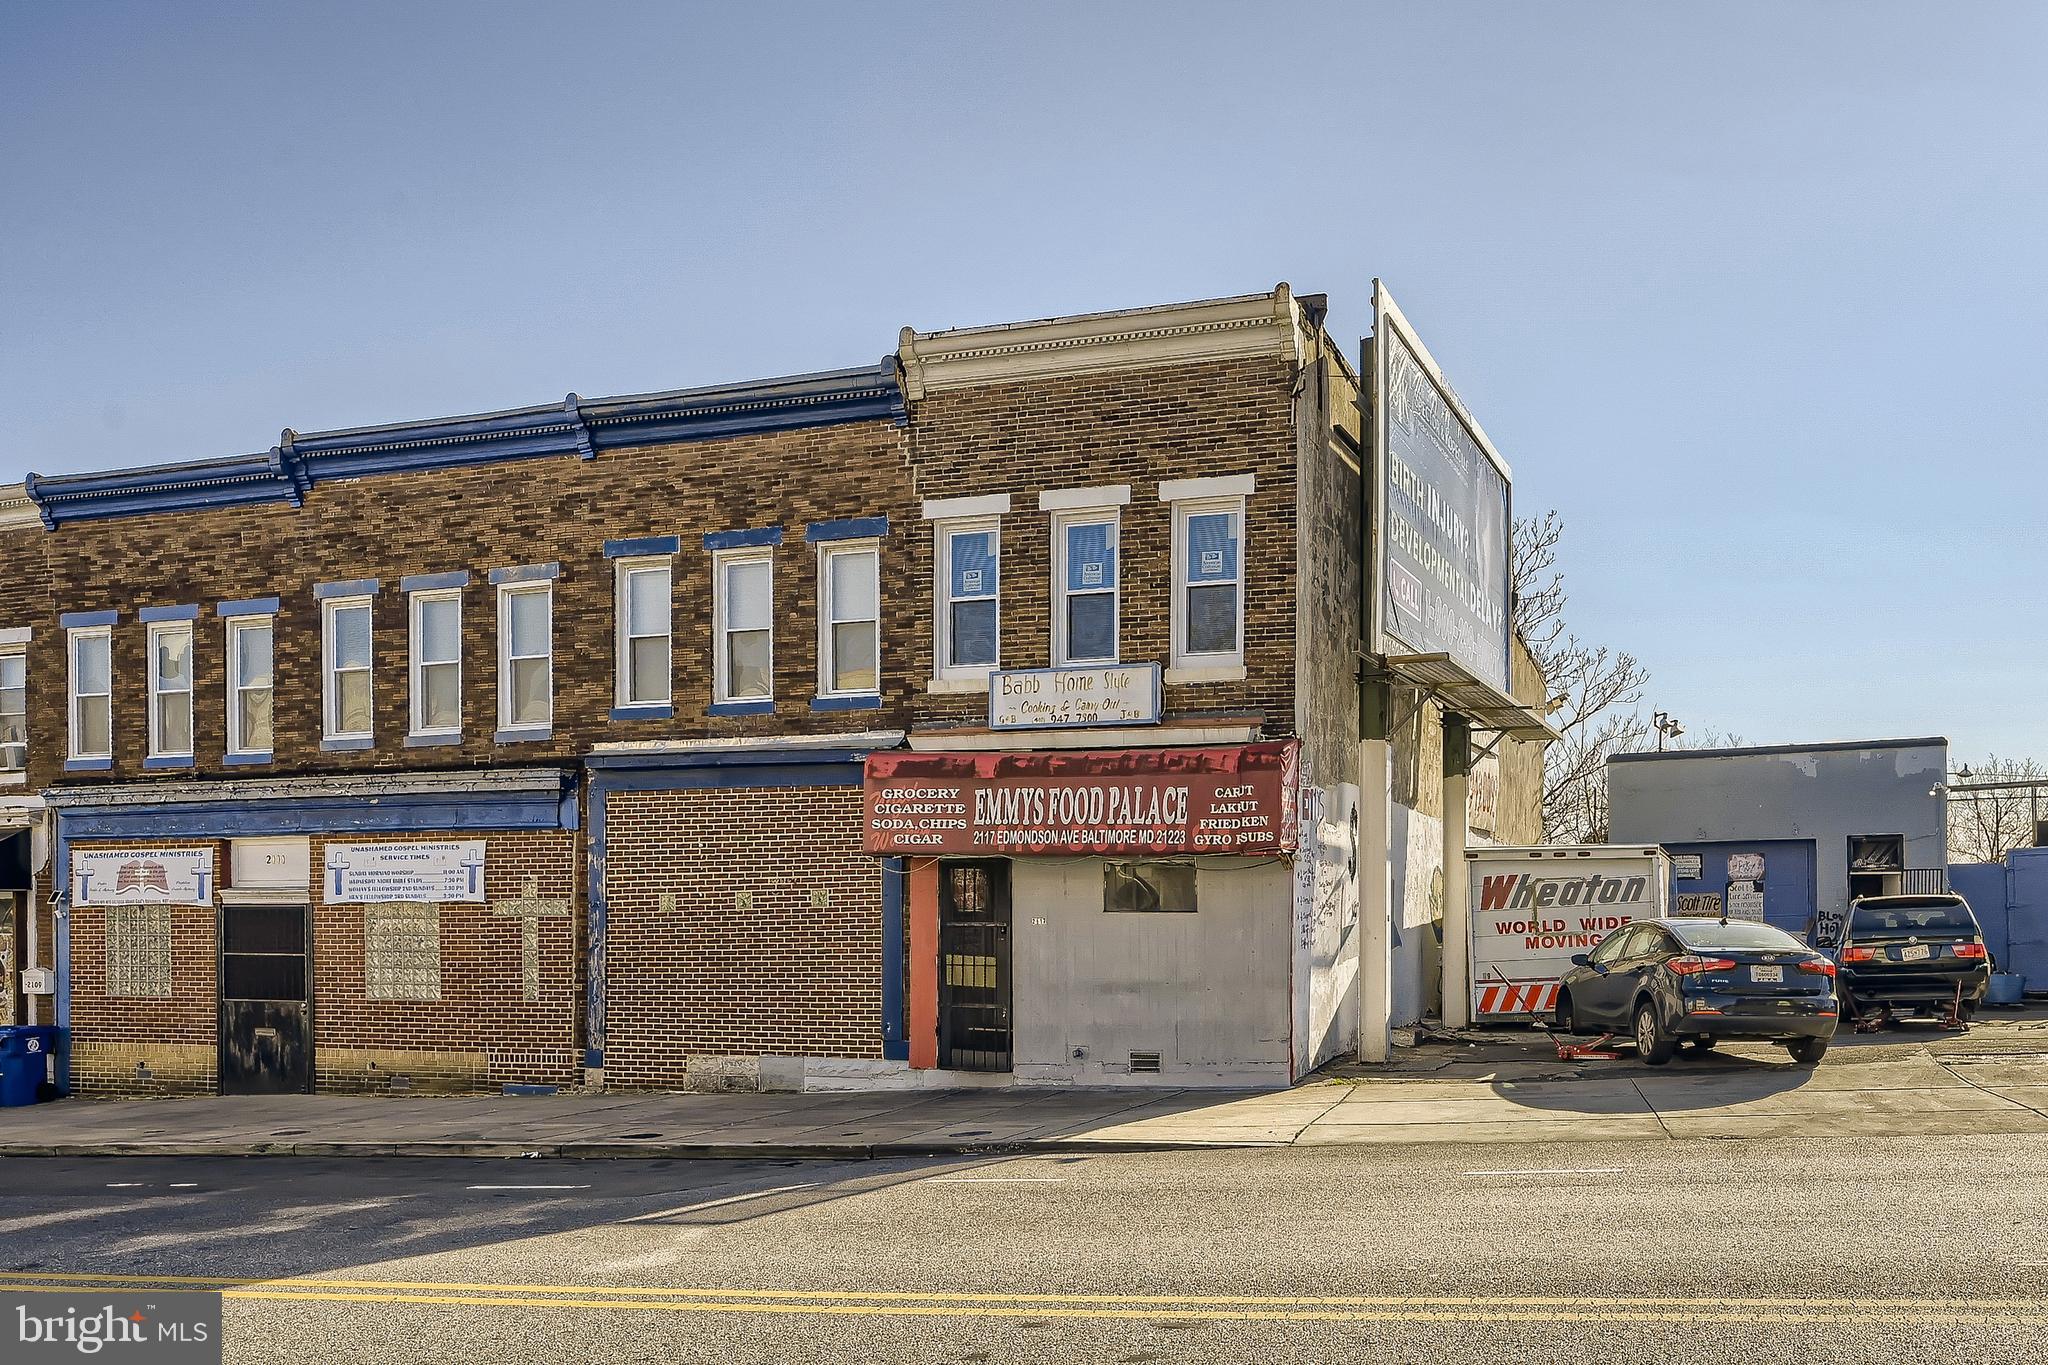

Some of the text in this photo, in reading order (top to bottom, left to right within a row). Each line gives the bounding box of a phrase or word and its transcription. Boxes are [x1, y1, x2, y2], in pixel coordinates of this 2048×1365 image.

[1391, 451, 1424, 511] BIRTH
[1427, 482, 1470, 560] INJURY?
[1391, 509, 1503, 637] DEVELOPMENTAL DELAY?
[1401, 577, 1419, 612] CALL
[1002, 674, 1040, 695] Babb
[1055, 672, 1093, 693] Home
[1021, 700, 1056, 714] Cooking
[1060, 700, 1070, 710] &
[1050, 714, 1070, 723] 947
[881, 788, 960, 799] GROCERY
[874, 803, 966, 814] CIGARETTE
[973, 786, 1189, 826] EMMYS FOOD PALACE
[1199, 819, 1240, 830] FRIED
[893, 834, 943, 844] CIGAR
[973, 829, 1186, 845] 2117 EDMONDSON AVE BALTIMORE MD 21223
[1194, 834, 1232, 845] GYRO
[1480, 873, 1647, 911] Wheaton
[1678, 895, 1700, 911] Scott
[1495, 919, 1566, 935] WORLD
[1525, 933, 1602, 950] MOVING
